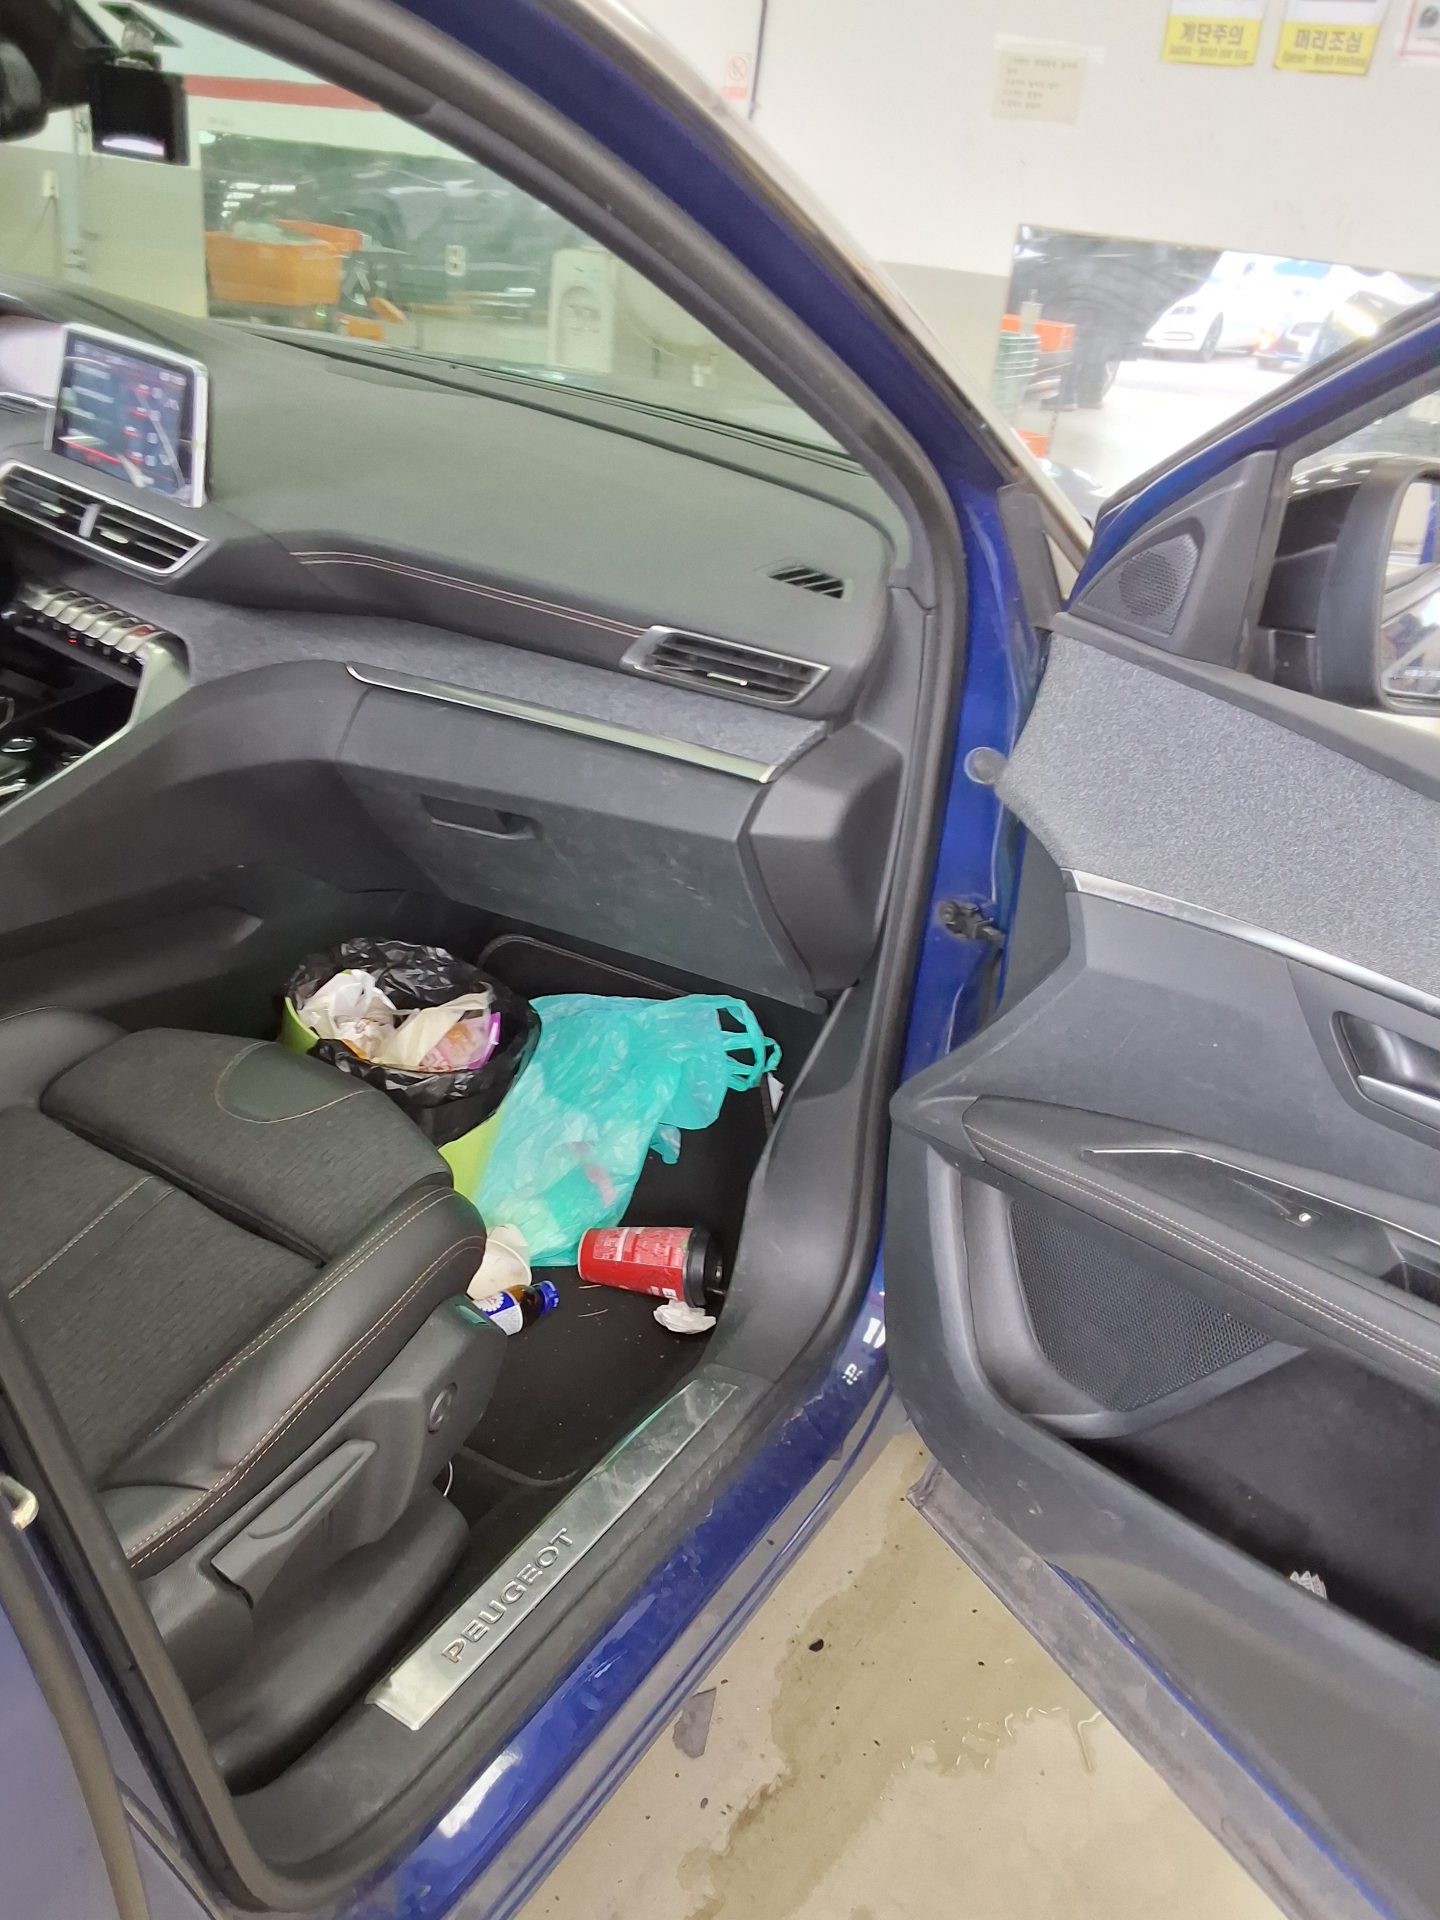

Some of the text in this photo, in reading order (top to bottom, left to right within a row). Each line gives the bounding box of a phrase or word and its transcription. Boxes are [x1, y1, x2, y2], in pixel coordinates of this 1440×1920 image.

[1179, 22, 1245, 45] 계단주의
[1294, 28, 1363, 53] 머리조심
[441, 1527, 574, 1664] PEUGEOT
